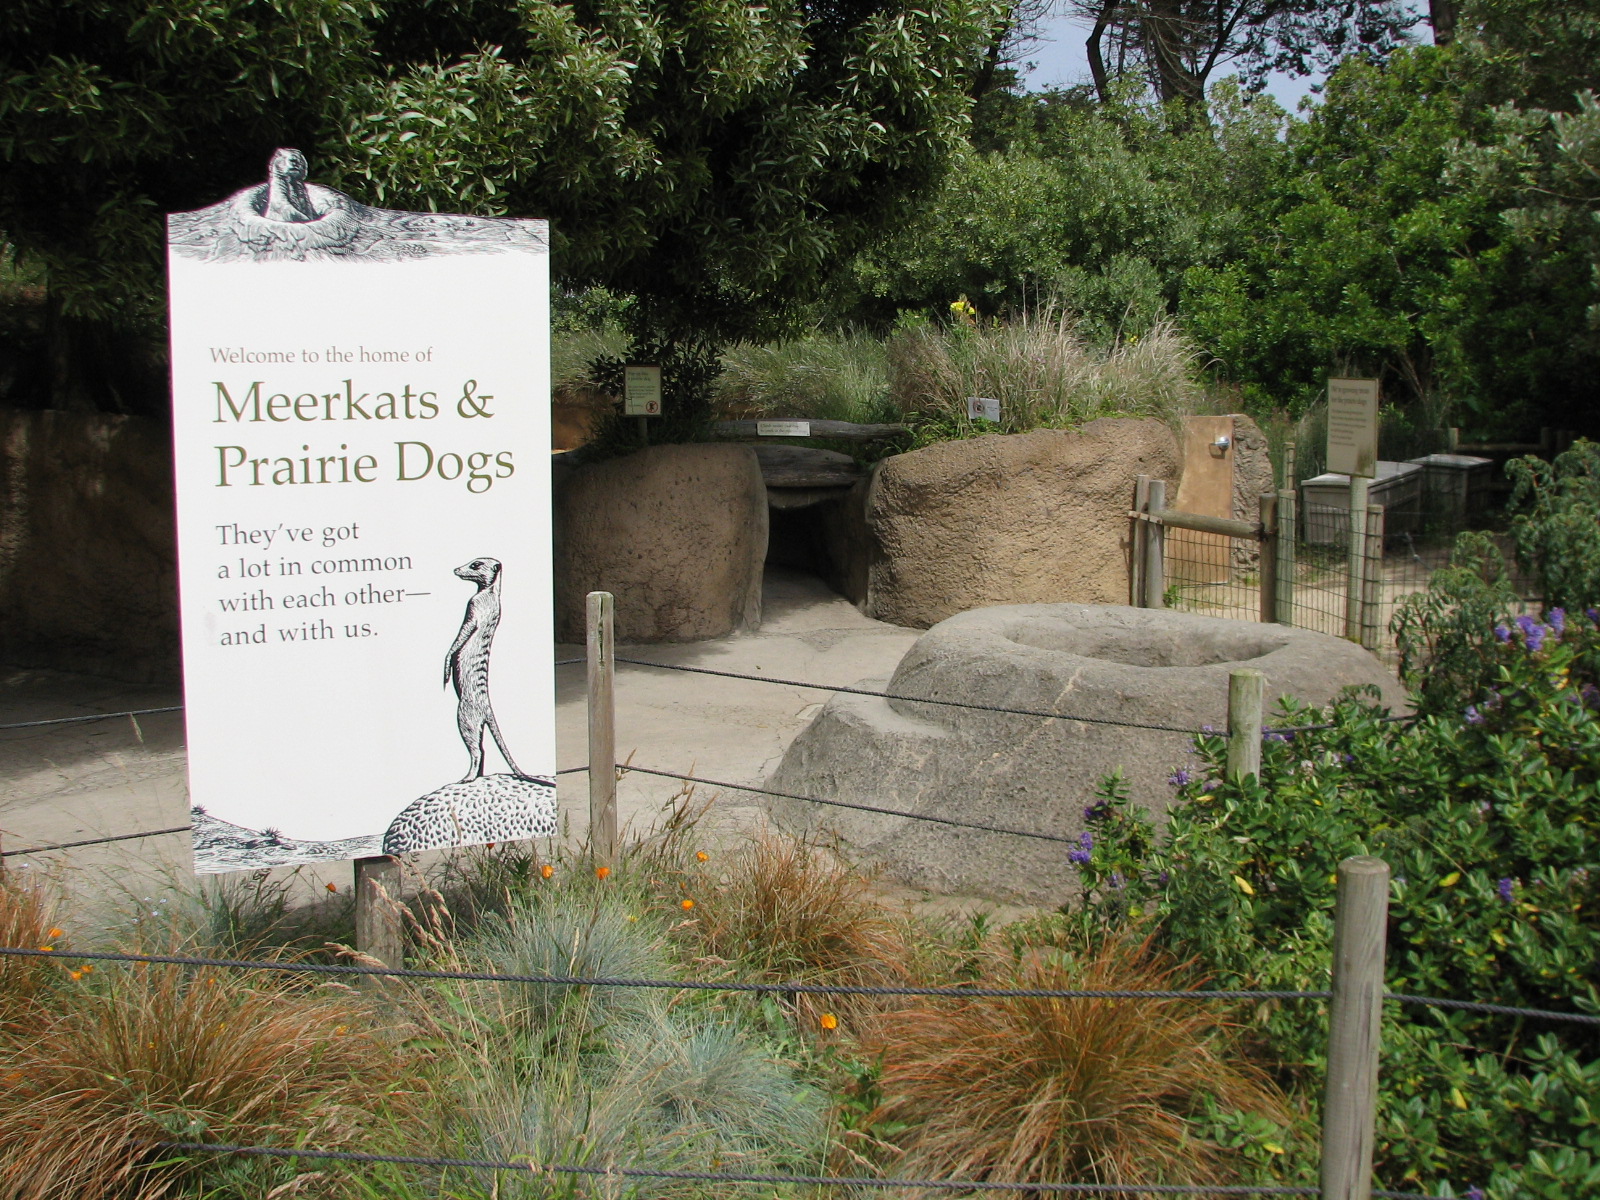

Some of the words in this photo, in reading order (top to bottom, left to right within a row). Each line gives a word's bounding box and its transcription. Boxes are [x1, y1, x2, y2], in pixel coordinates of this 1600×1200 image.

[210, 347, 296, 364] Welcome
[302, 349, 320, 364] to
[325, 346, 354, 363] the
[359, 346, 410, 363] home
[416, 346, 433, 363] of
[210, 379, 440, 423] Meerkats
[457, 379, 495, 419] &
[214, 443, 378, 487] Prairie
[394, 441, 515, 494] Dogs
[322, 522, 360, 548] got
[217, 565, 230, 580] a
[239, 558, 270, 578] lot
[280, 557, 303, 576] in
[311, 556, 413, 576] common
[219, 588, 275, 613] with
[282, 585, 336, 610] each
[220, 624, 268, 647] and
[278, 619, 335, 643] with
[344, 623, 379, 639] us.
